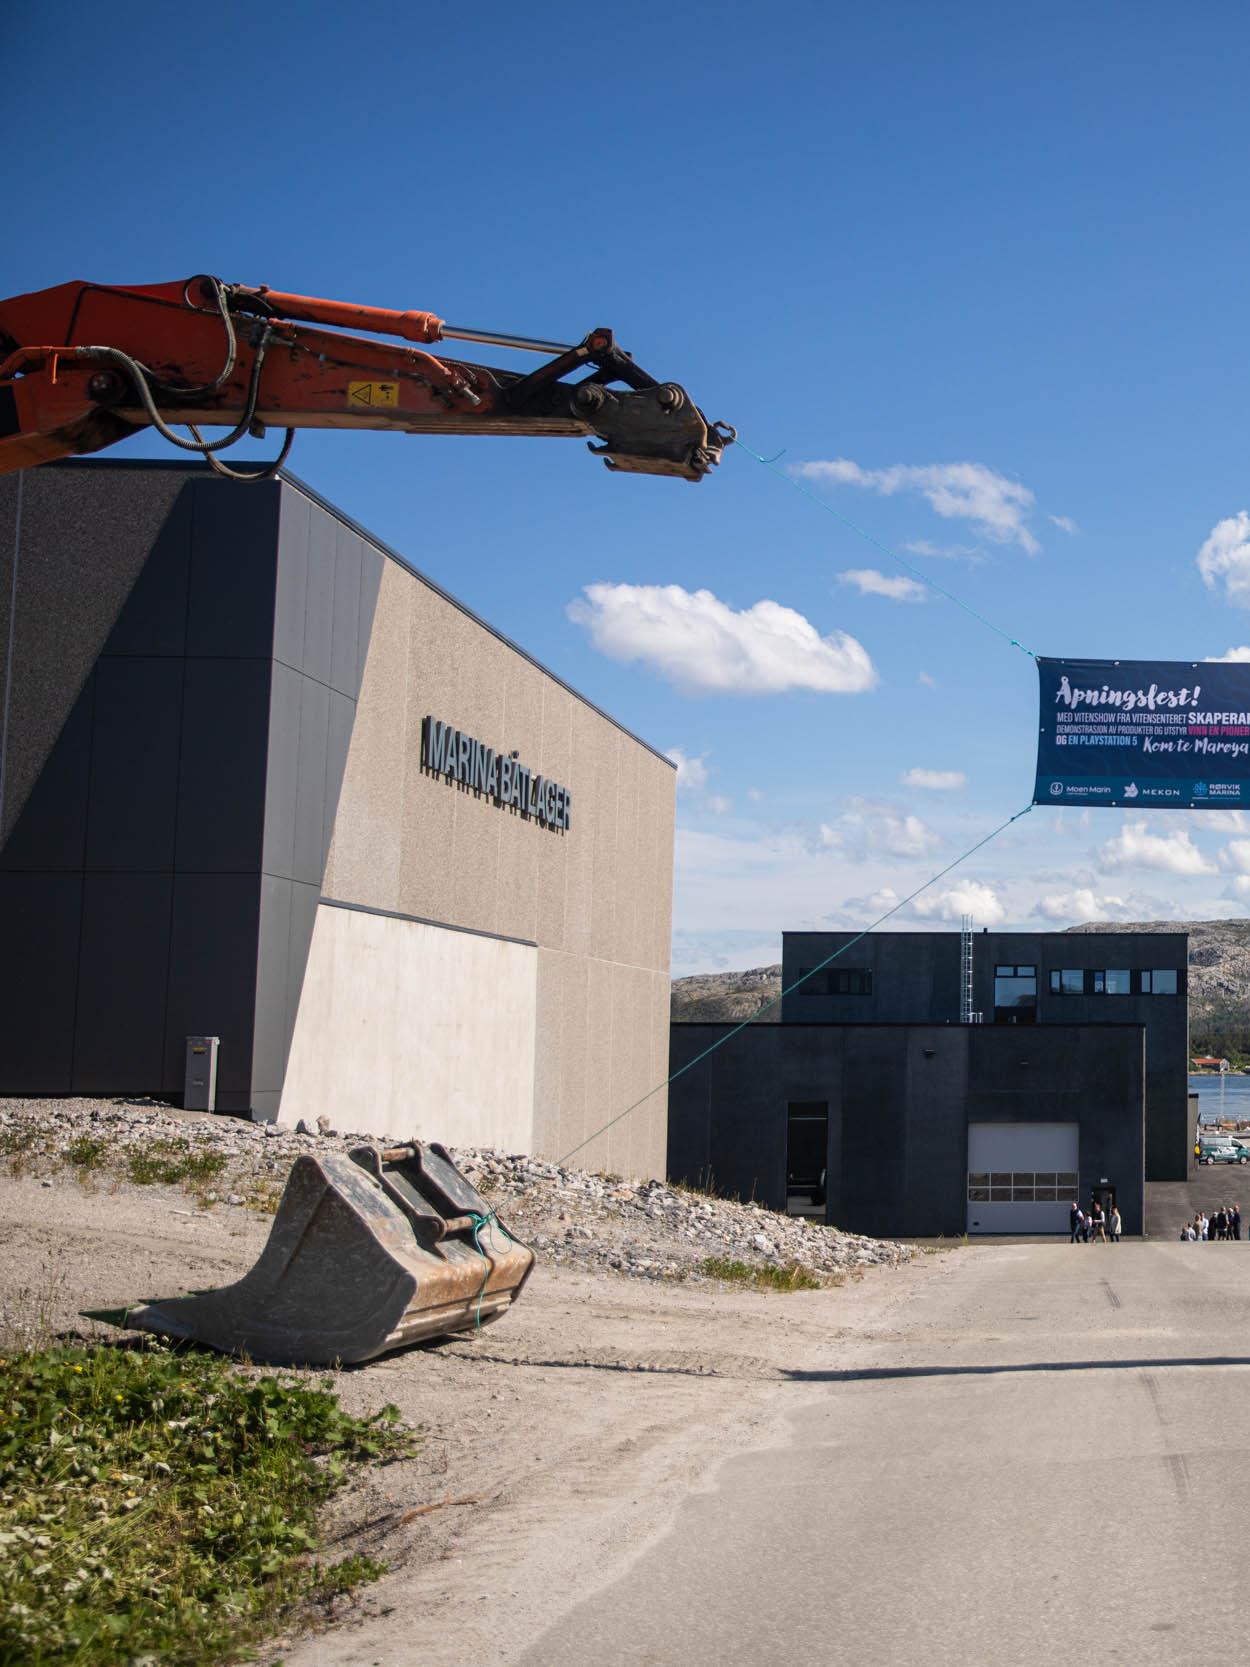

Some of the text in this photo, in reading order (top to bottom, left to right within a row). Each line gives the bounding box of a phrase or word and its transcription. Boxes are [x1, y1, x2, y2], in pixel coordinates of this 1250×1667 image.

[1055, 676, 1201, 711] Åpningsfest!
[1057, 712, 1186, 724] MED VITENSHOW FRA VITENSENTERET
[1056, 724, 1187, 736] DEMONSTRASJON AV PRODUKTER OG UTSTYR
[1188, 725, 1208, 736] VINN
[1208, 726, 1219, 736] EN
[1220, 726, 1250, 736] PIONER
[1056, 735, 1138, 746] OG EN PLAYSTATION 5
[1143, 736, 1176, 753] Kom
[1176, 738, 1193, 752] te
[425, 715, 499, 798] MARINA
[1066, 785, 1088, 793] Moen
